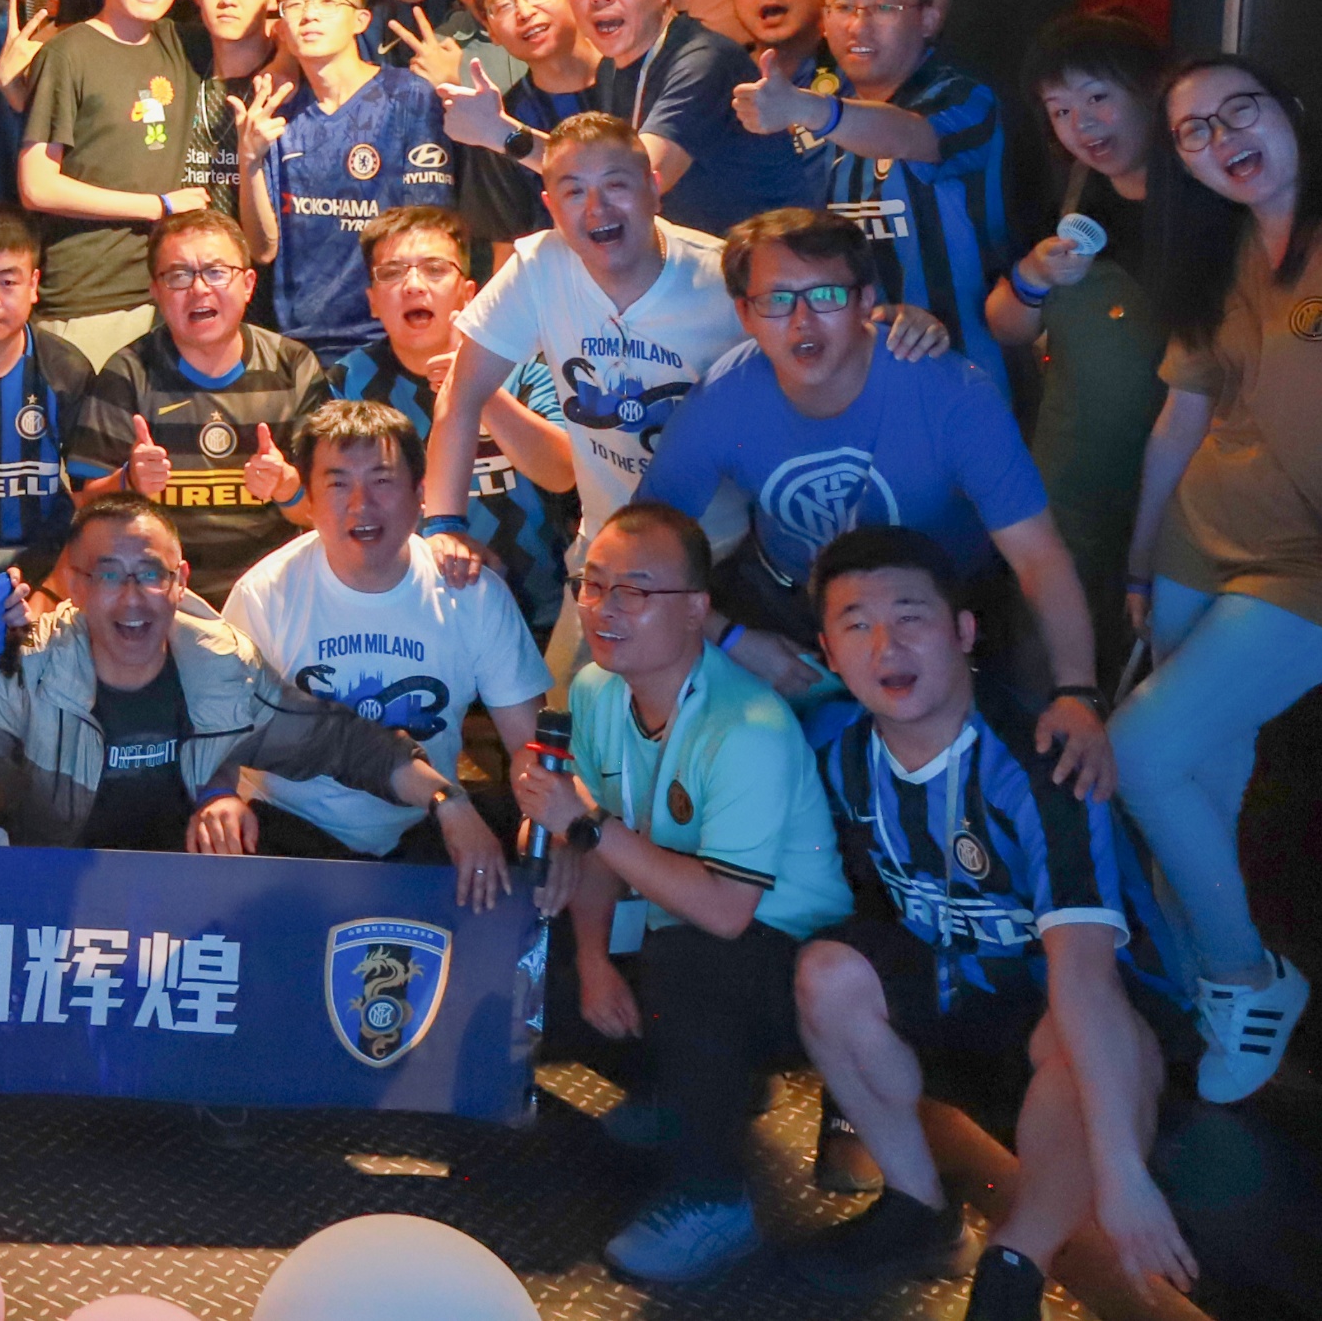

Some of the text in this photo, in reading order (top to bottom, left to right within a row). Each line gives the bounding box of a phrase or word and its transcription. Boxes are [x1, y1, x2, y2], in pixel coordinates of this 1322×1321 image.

[291, 196, 379, 218] YOKOHAMA
[581, 337, 684, 369] FROM MILANO
[608, 450, 636, 475] THE
[318, 633, 425, 662] FROM MILANO
